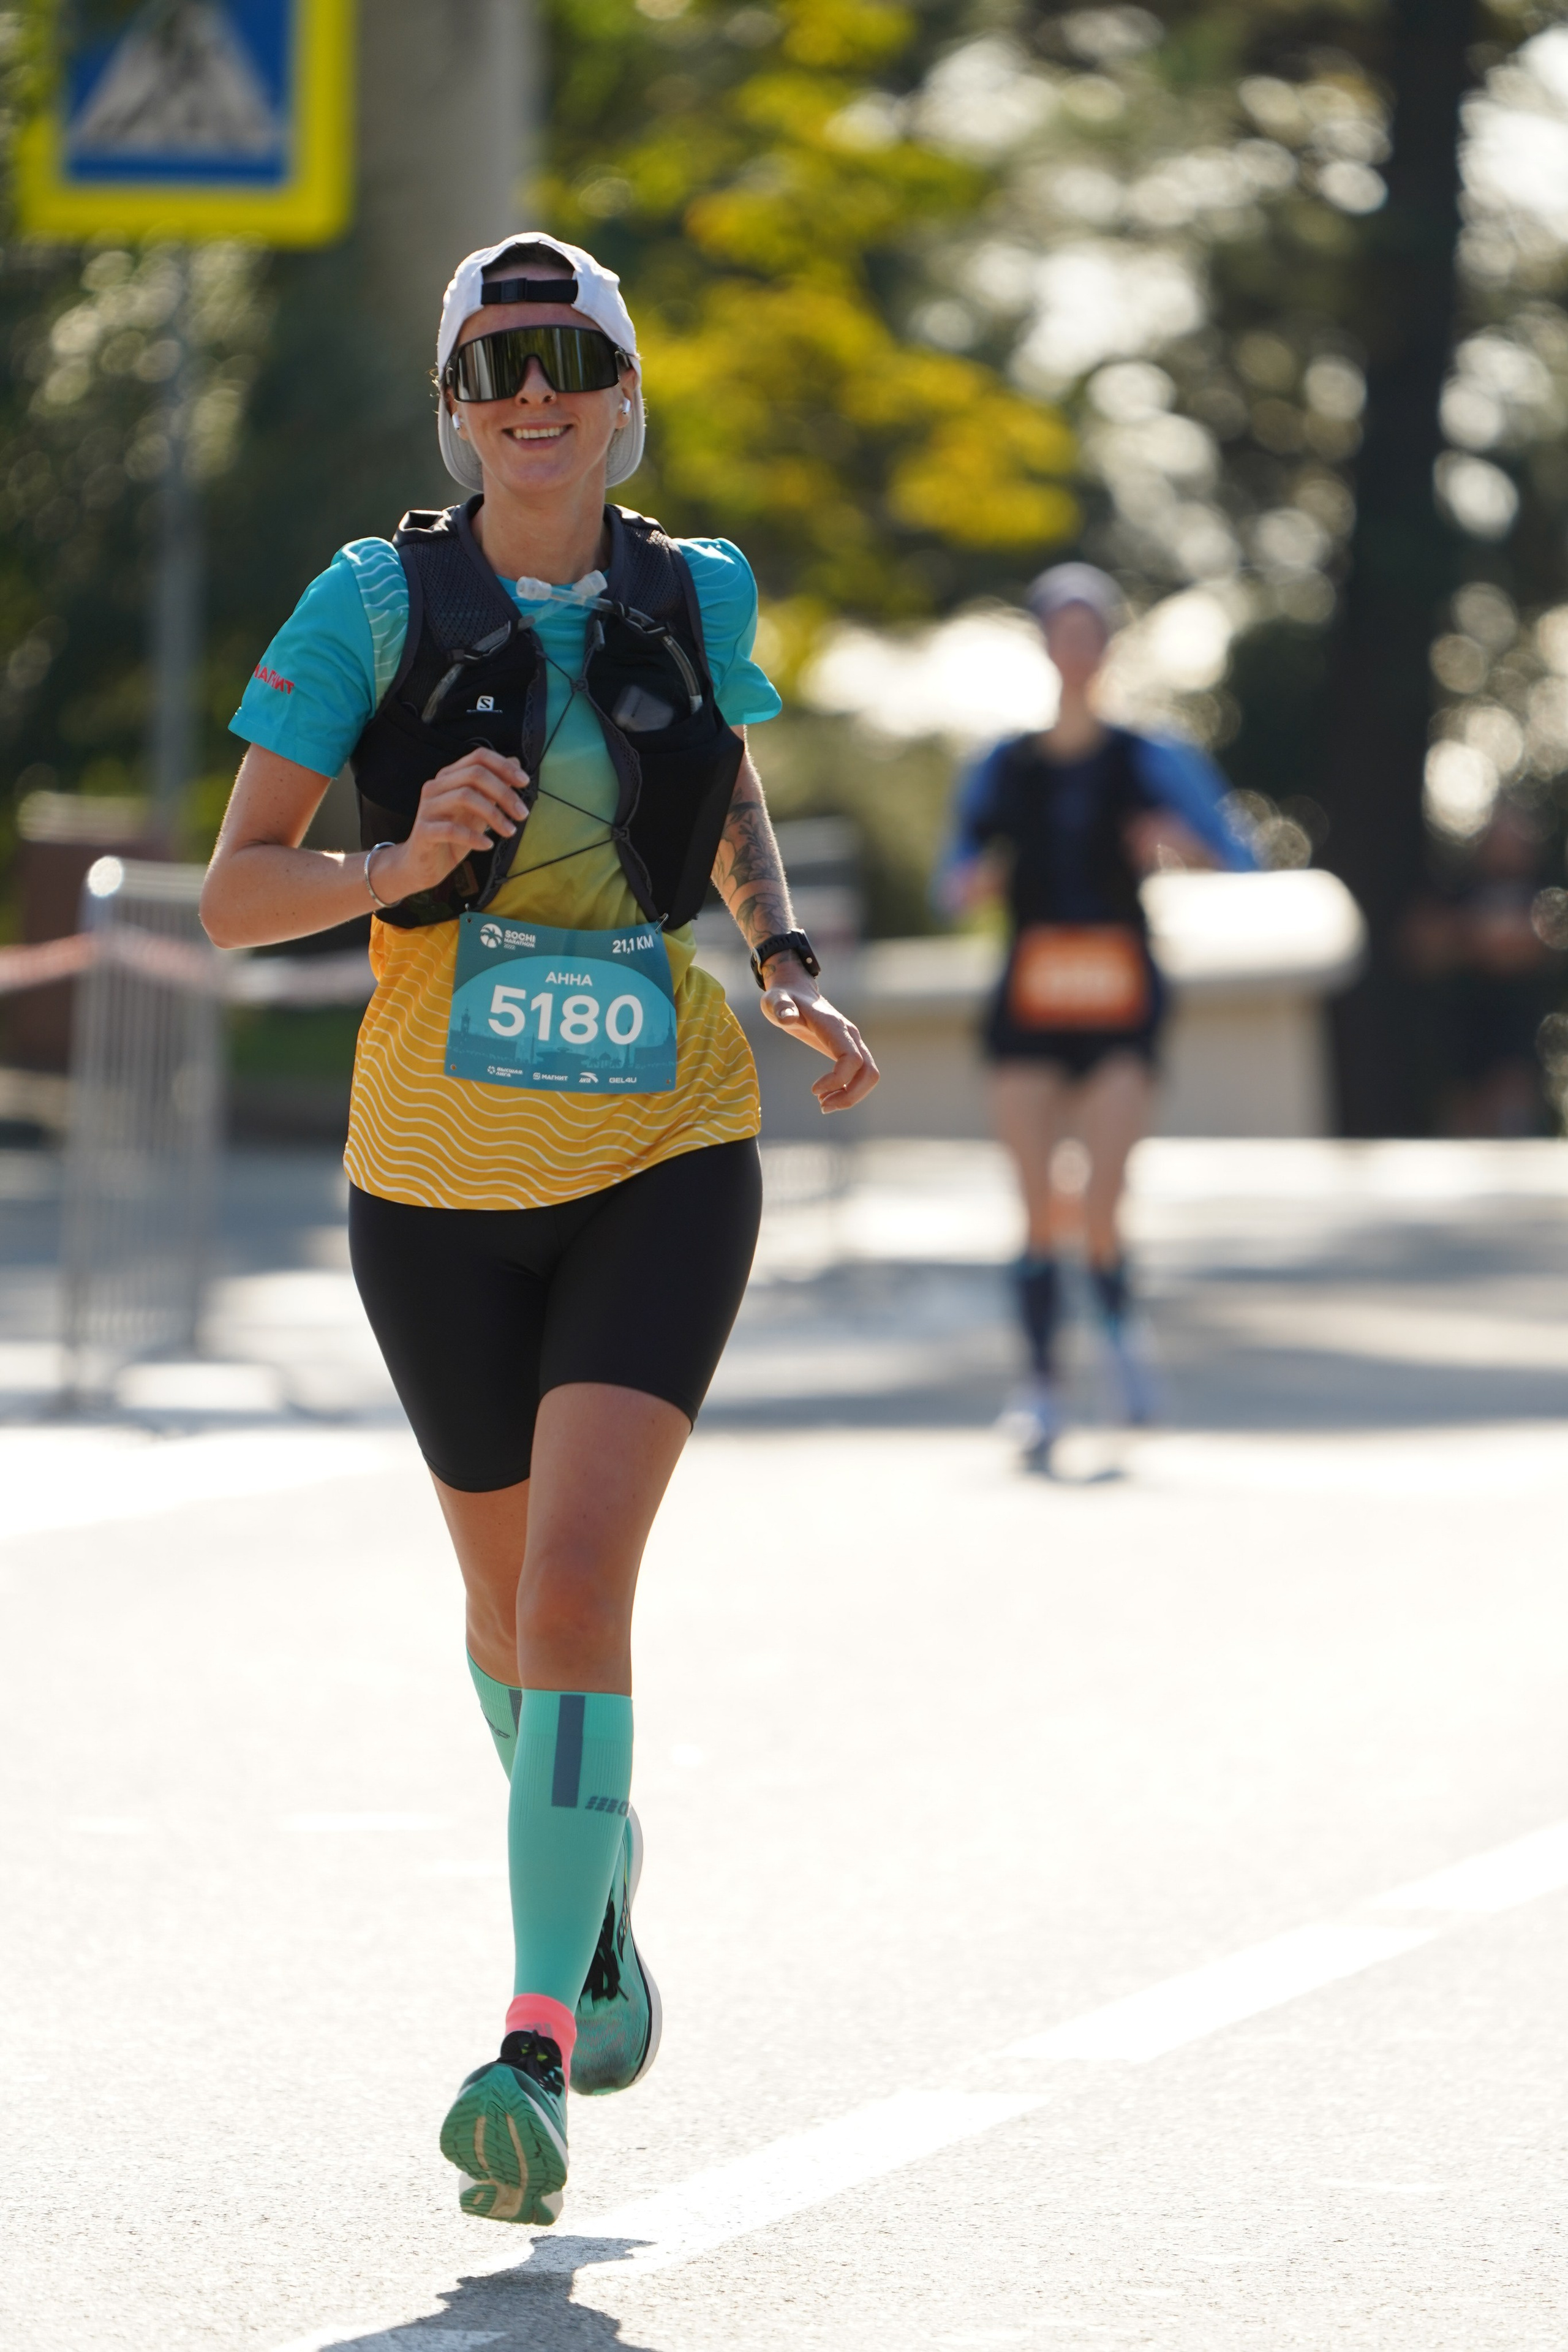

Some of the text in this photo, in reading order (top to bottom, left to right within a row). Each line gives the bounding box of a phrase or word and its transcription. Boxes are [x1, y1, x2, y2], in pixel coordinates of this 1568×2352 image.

[503, 938, 535, 948] MARATHON
[505, 930, 536, 943] SOCHI
[612, 935, 654, 954] 21,1 KM
[545, 971, 592, 986] АННА
[488, 984, 644, 1045] 5180
